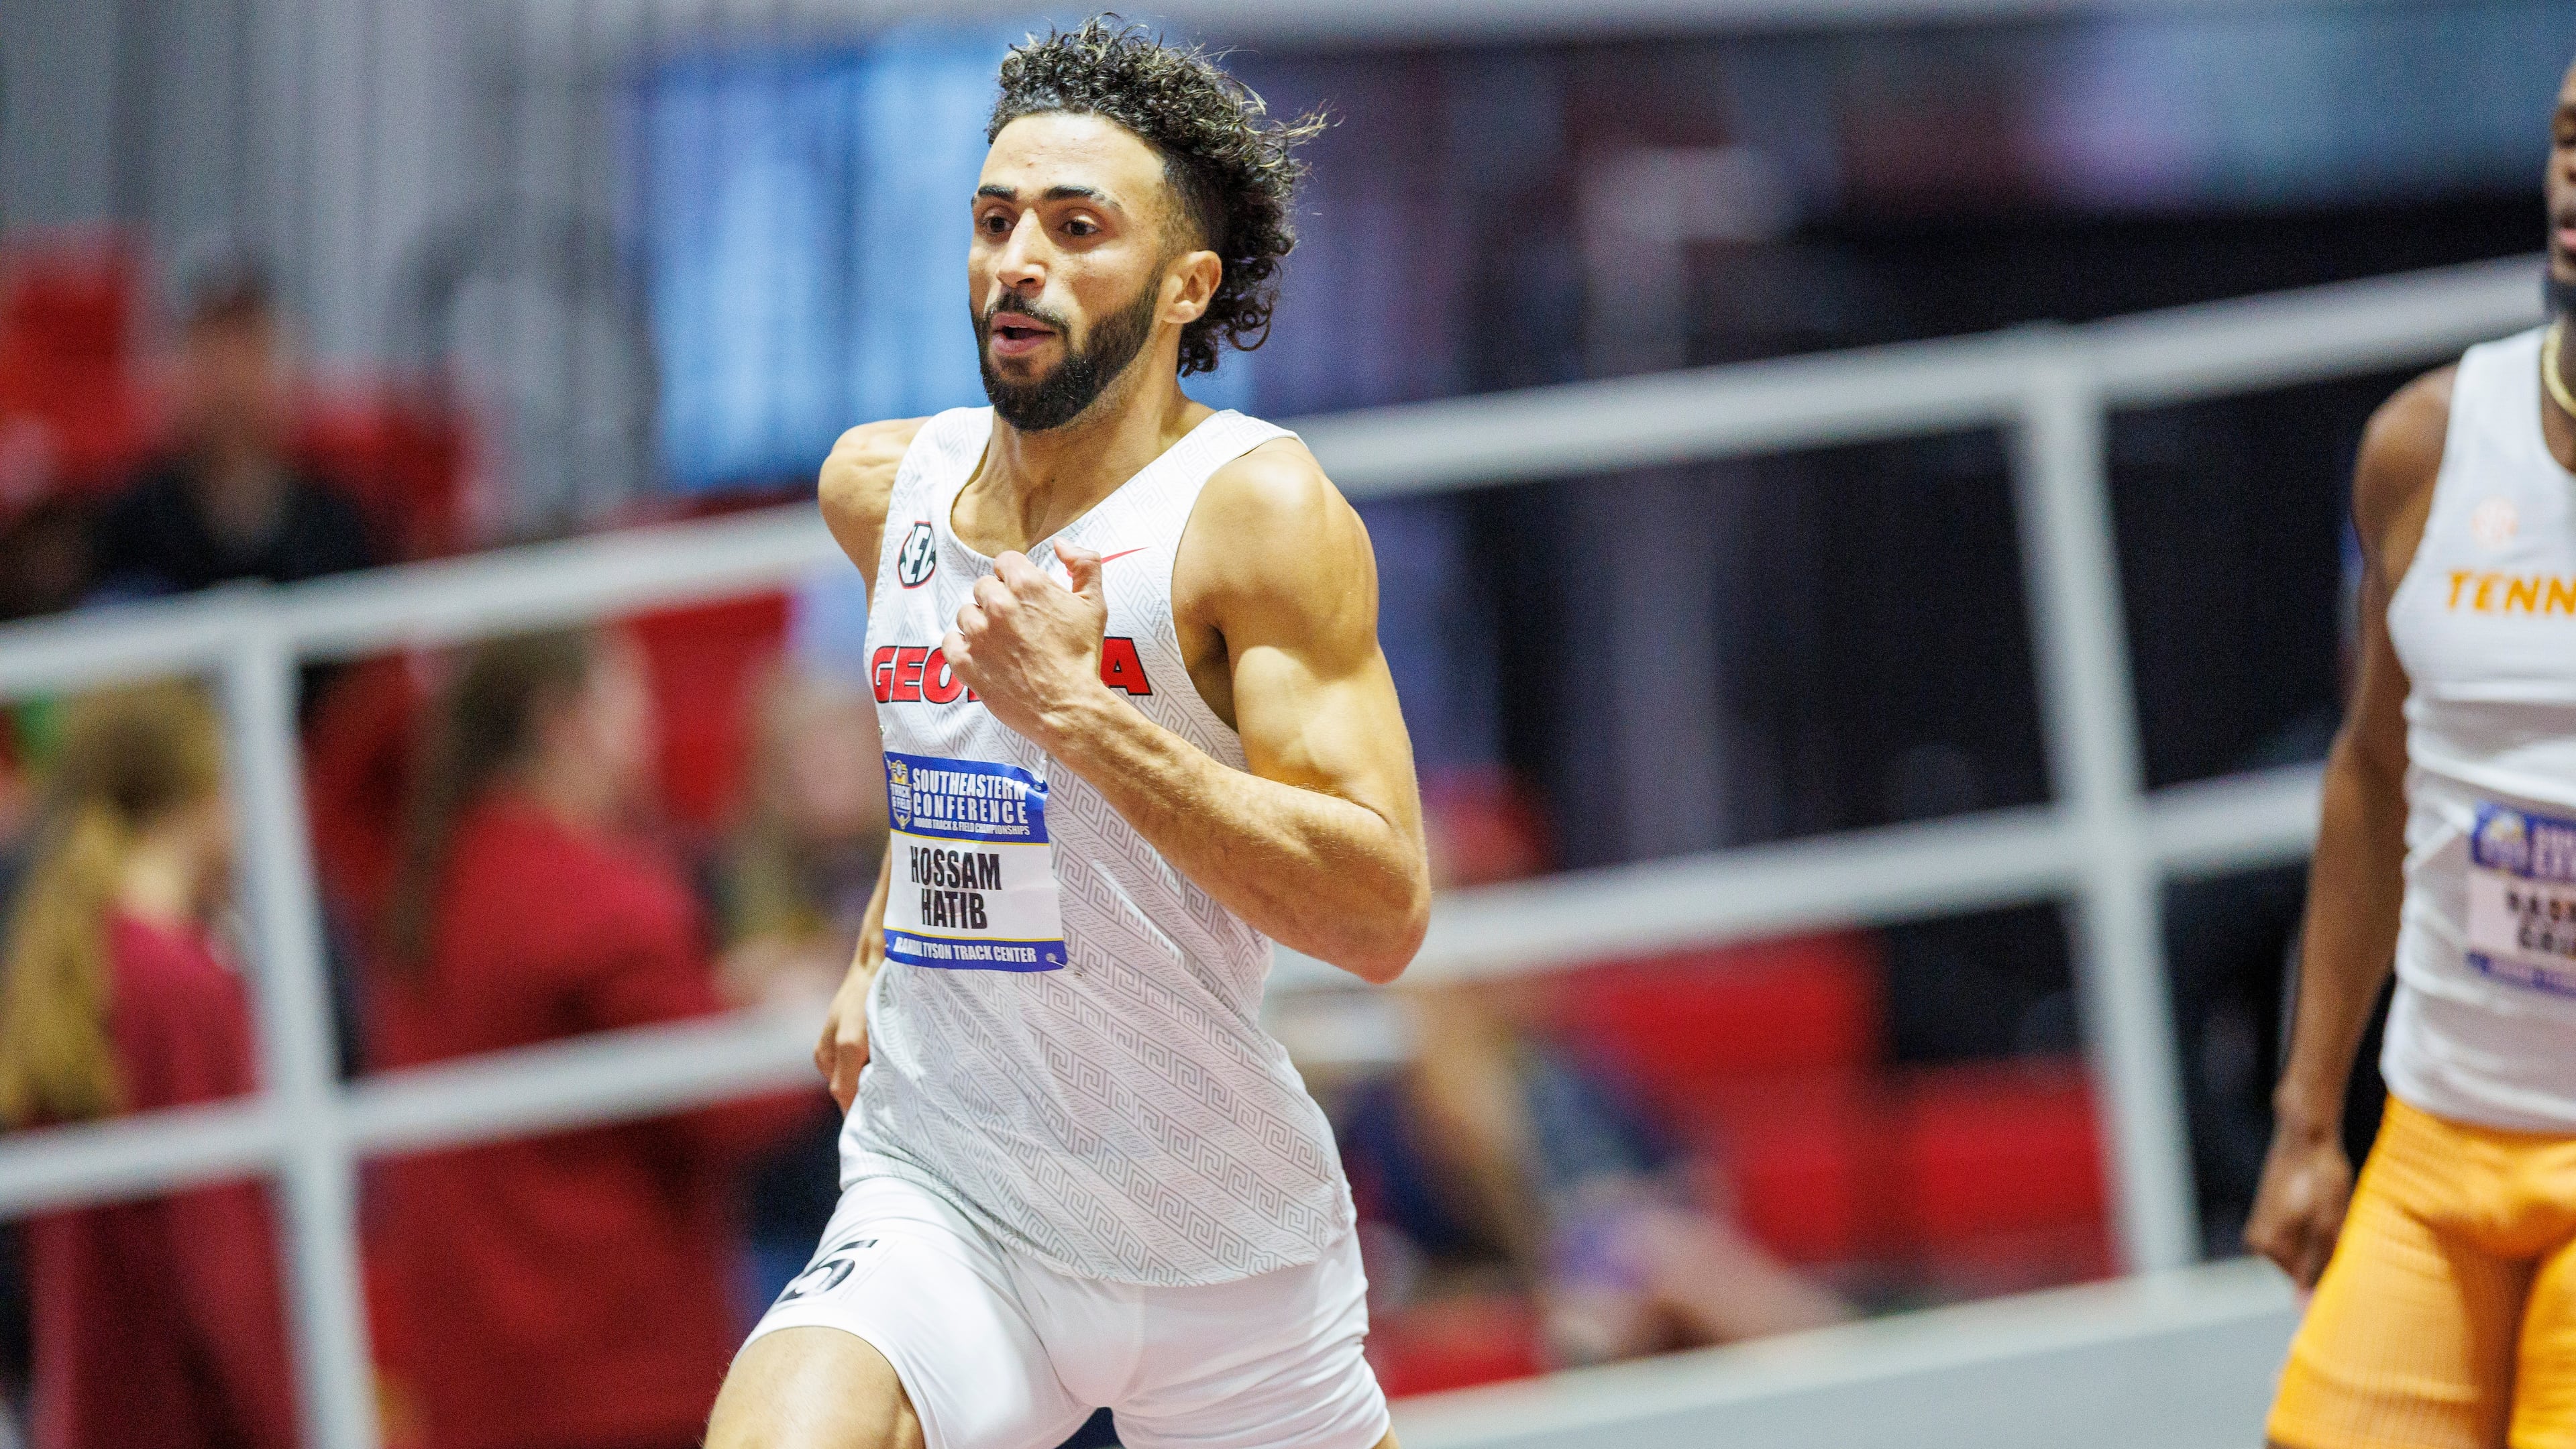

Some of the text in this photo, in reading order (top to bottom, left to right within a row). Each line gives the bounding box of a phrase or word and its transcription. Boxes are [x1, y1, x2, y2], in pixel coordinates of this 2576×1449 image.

[872, 637, 1152, 704] GEOA
[912, 767, 1030, 800] SOUTHEASTERN
[912, 792, 1029, 824] CONFERENCE
[952, 820, 959, 832] &
[910, 845, 1002, 890] HOSSAM
[921, 888, 988, 929] HATIB
[922, 942, 953, 960] TYSON
[953, 945, 994, 961] TRACK
[993, 946, 1037, 963] CENTER
